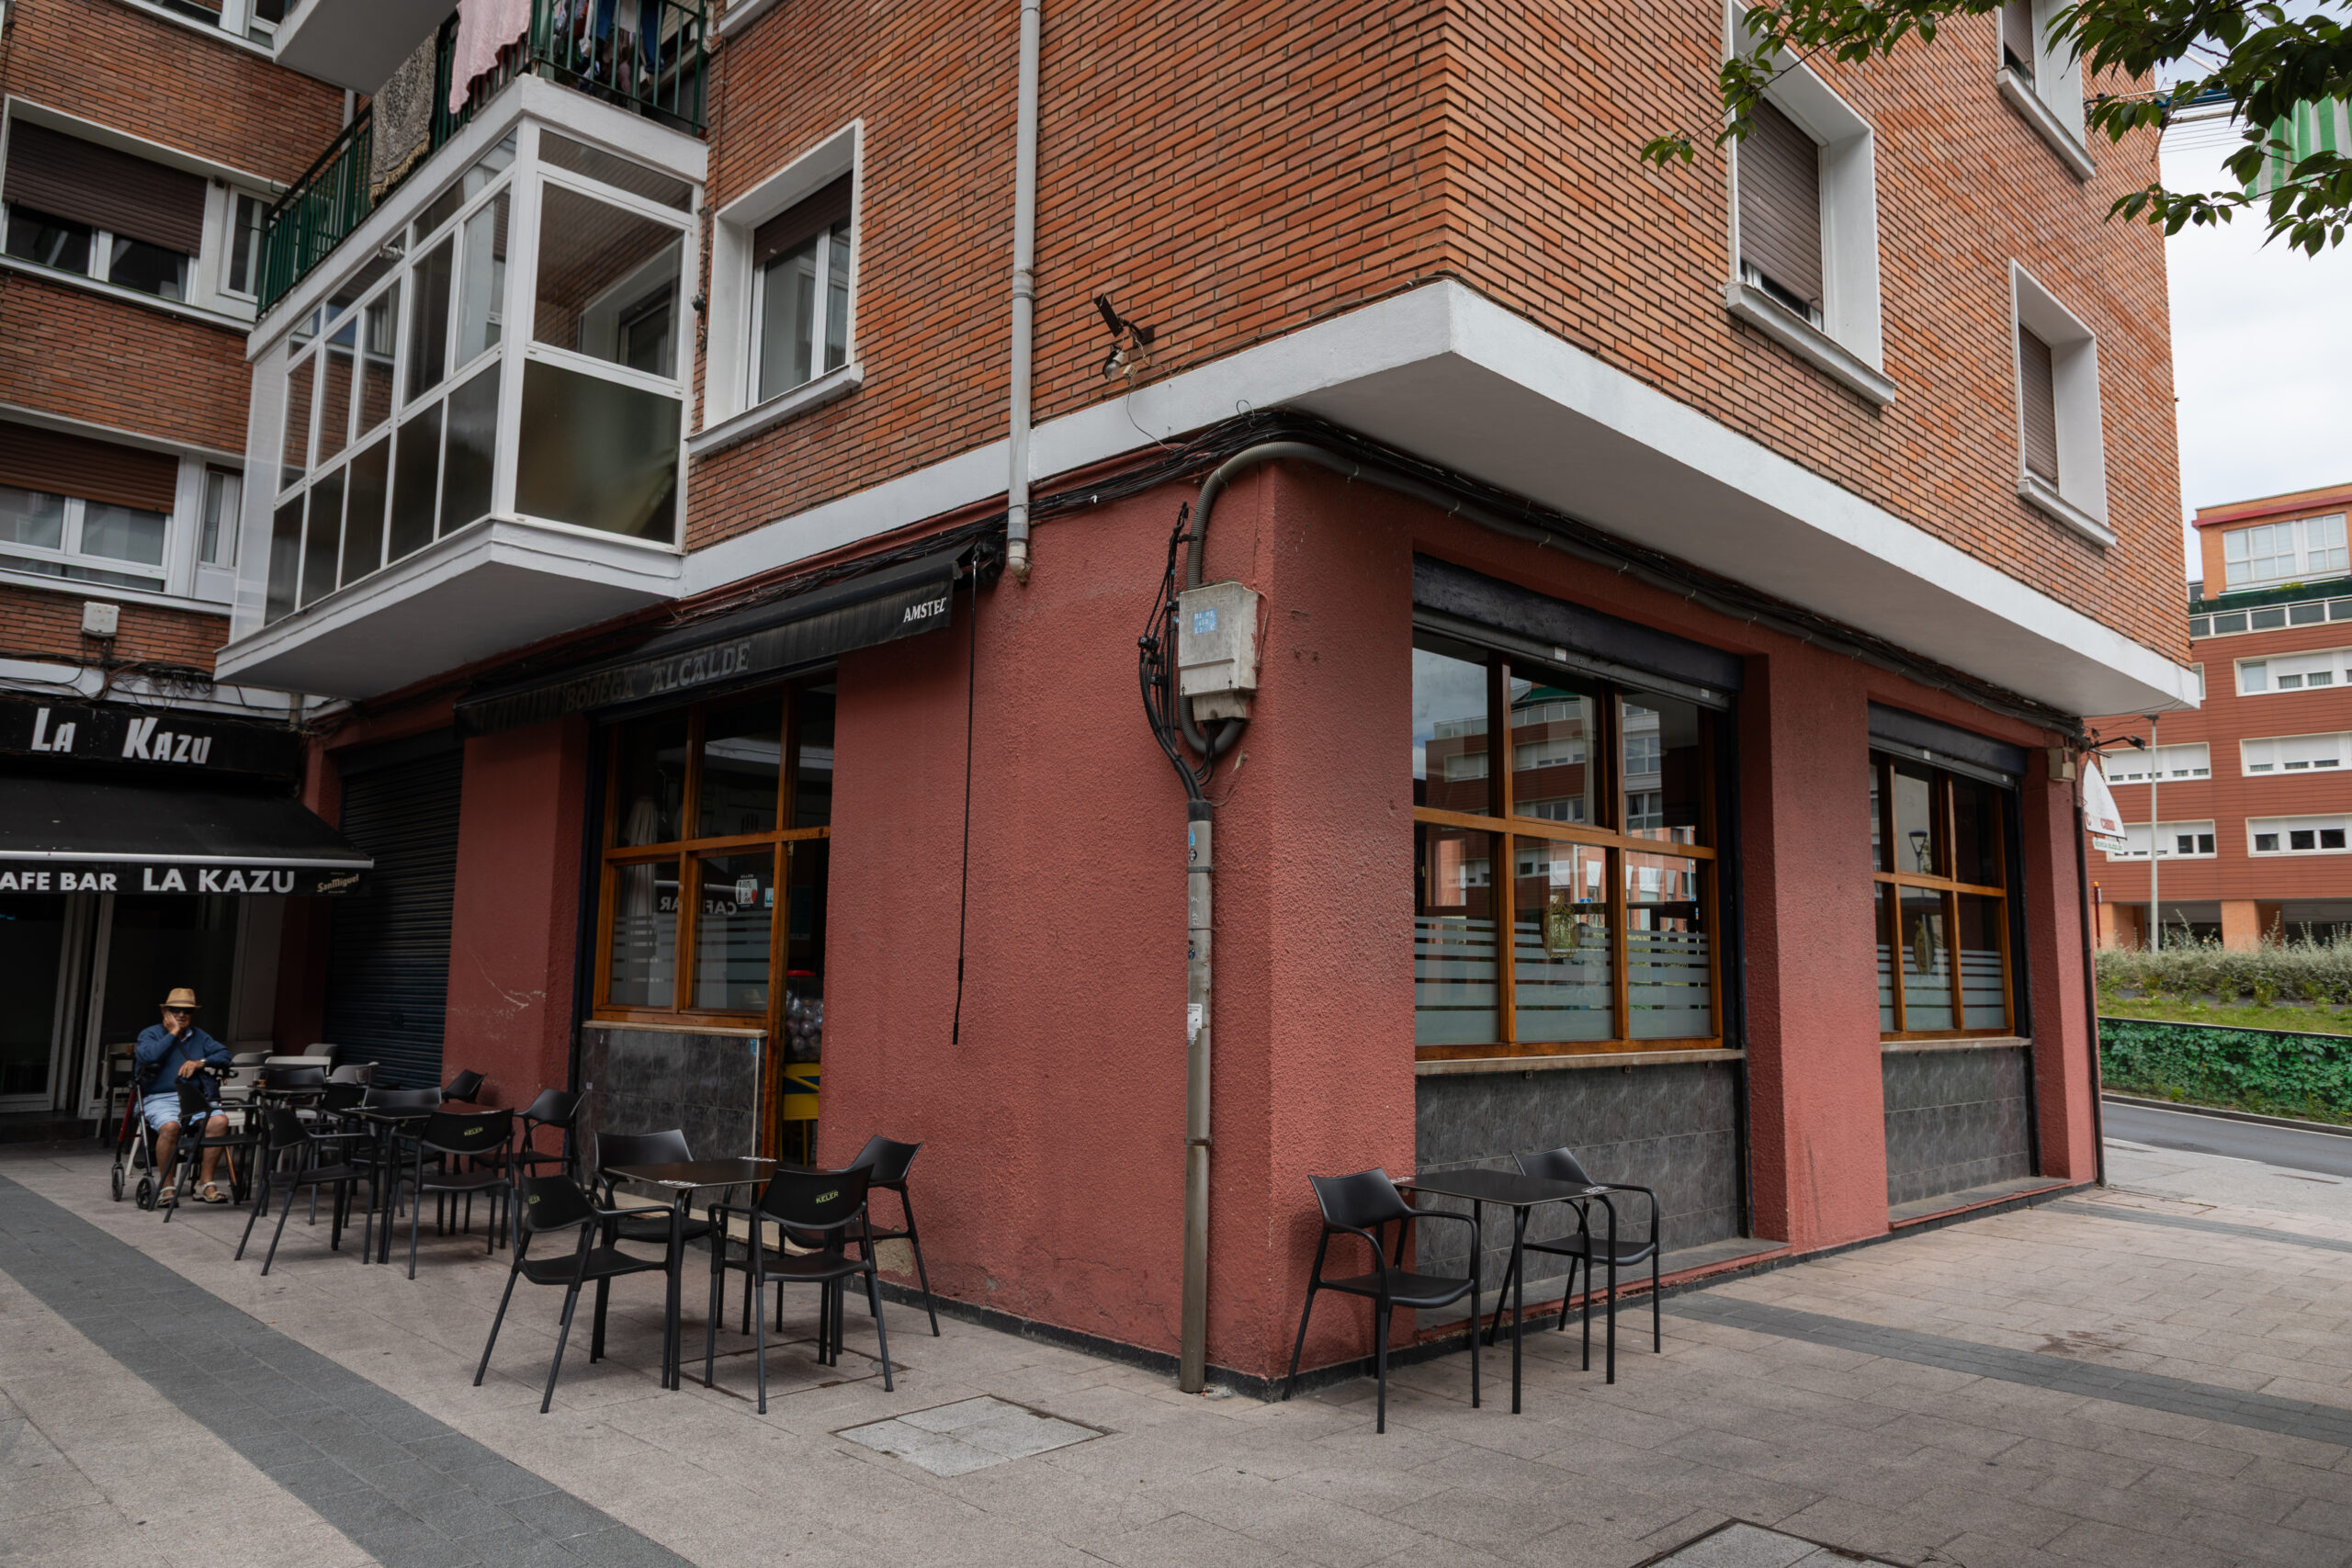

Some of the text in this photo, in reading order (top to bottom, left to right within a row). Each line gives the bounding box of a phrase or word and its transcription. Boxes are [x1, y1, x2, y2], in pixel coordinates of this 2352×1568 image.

[902, 596, 947, 624] AMSTEL
[649, 643, 752, 694] ALCALDE
[60, 872, 118, 891] BAR
[143, 867, 187, 892] LA
[198, 869, 295, 894] KAZU
[815, 1190, 839, 1204] KELER
